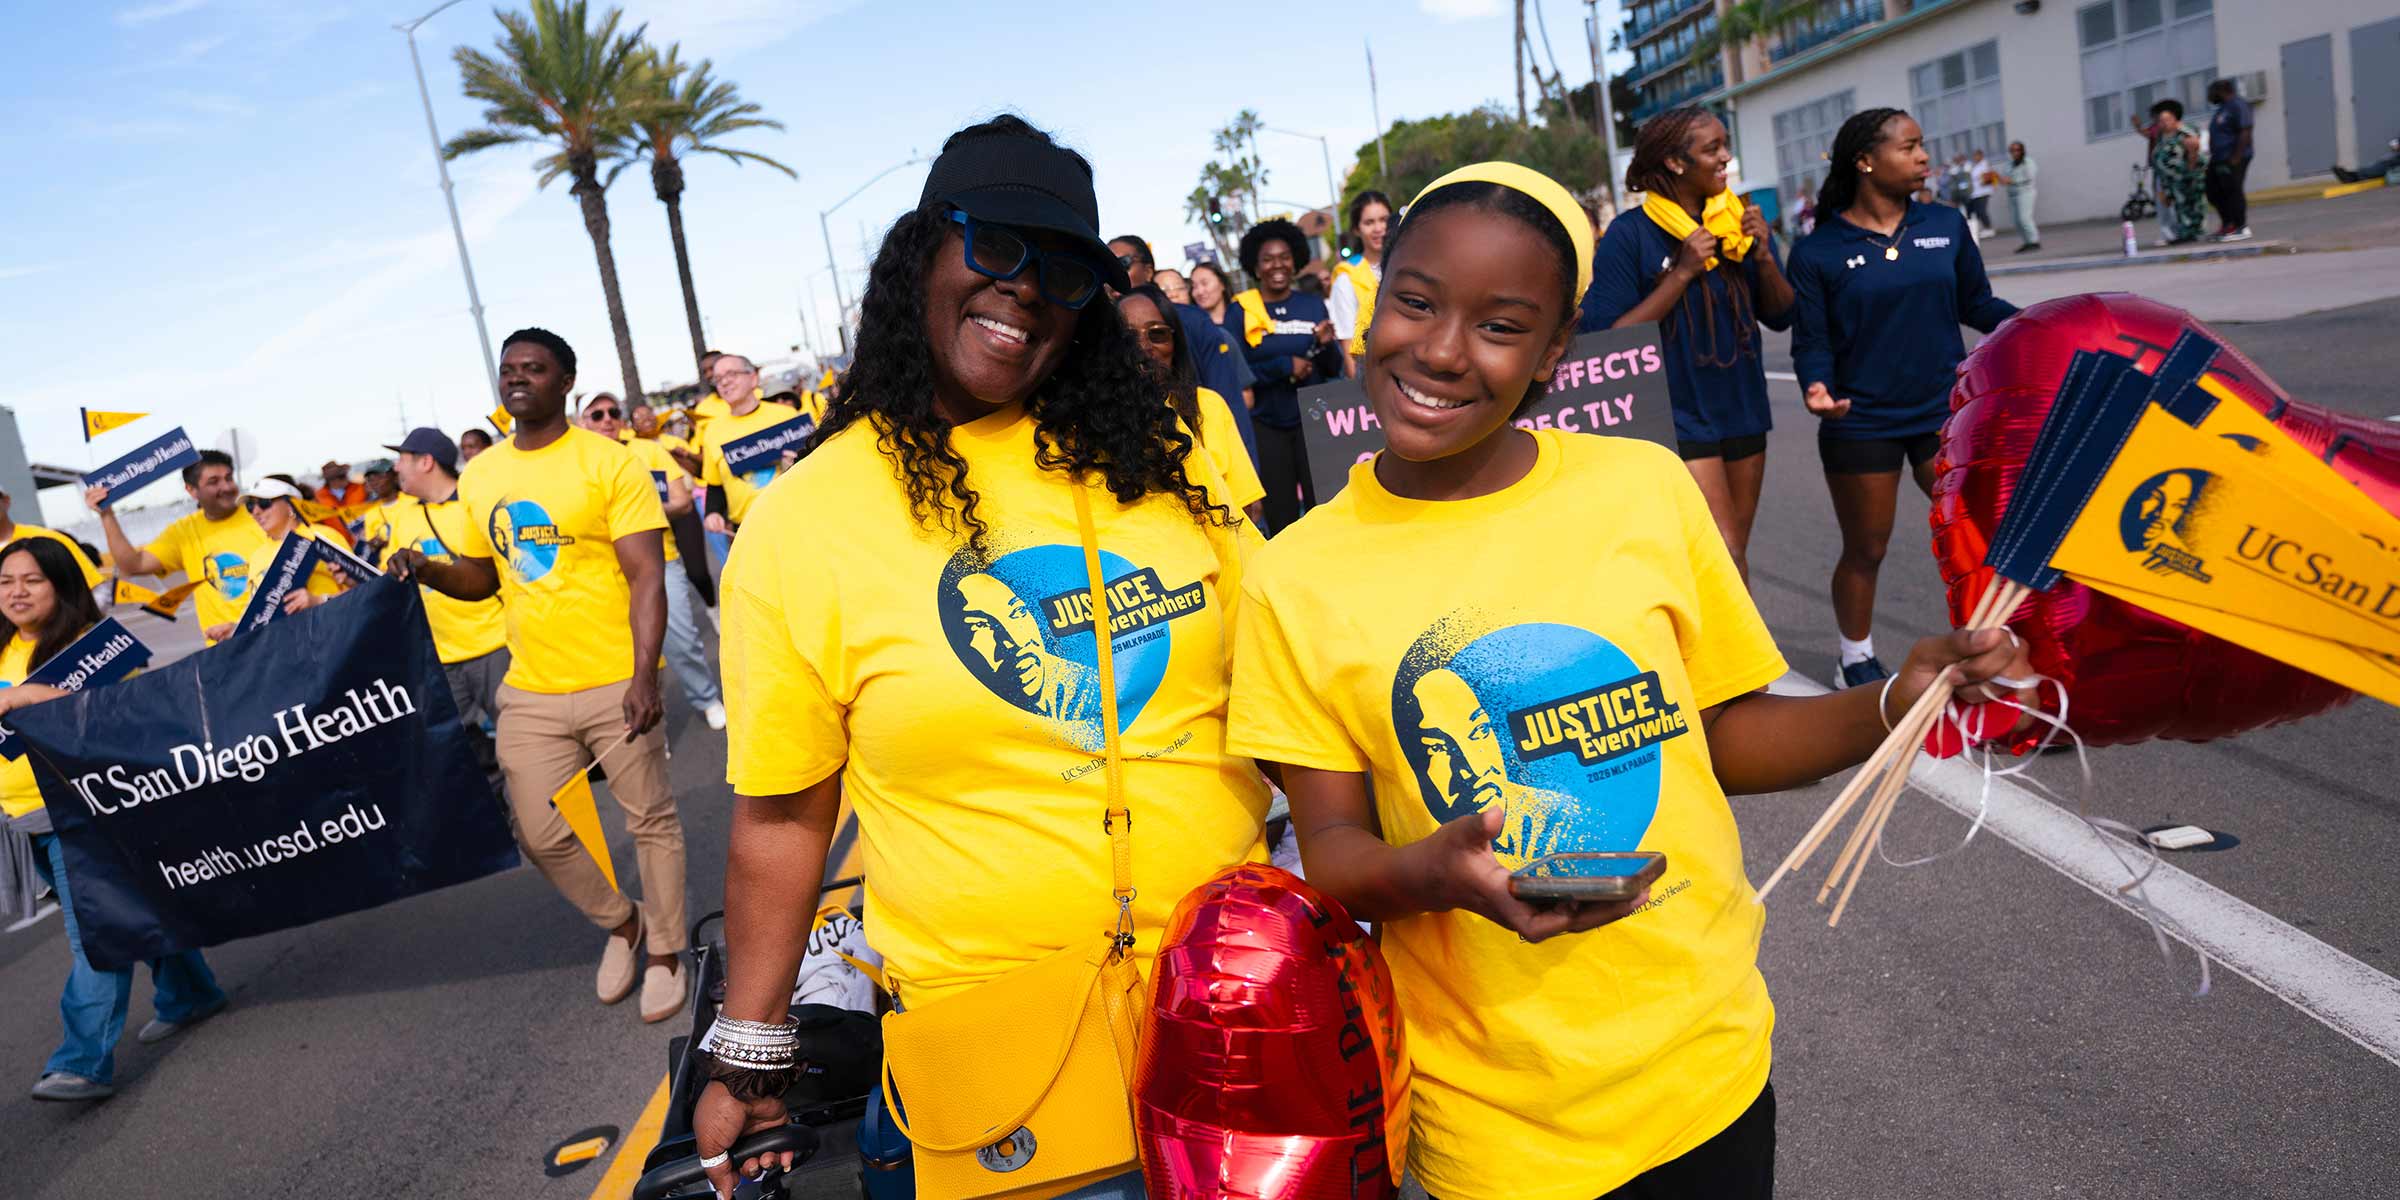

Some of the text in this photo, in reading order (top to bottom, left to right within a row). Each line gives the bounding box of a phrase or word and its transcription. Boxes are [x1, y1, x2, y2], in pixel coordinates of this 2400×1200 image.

[1546, 344, 1661, 394] FFECTS
[107, 471, 131, 489] San
[125, 454, 160, 478] Diego
[153, 438, 192, 463] Health
[2236, 524, 2304, 575] UC
[2294, 552, 2370, 607] San
[1052, 575, 1157, 629] JUSICE
[1108, 588, 1202, 633] verywhere
[77, 633, 135, 676] Health
[1121, 637, 1139, 650] MLK
[1138, 628, 1167, 645] PARADE
[1520, 680, 1656, 752] JUSTICE
[1577, 709, 1686, 759] Everywhe
[106, 764, 182, 809] San
[169, 732, 279, 793] Diego
[273, 678, 417, 758] Health
[1586, 750, 1657, 784] 2026 MLK PARADE
[1061, 767, 1079, 782] UC
[1077, 764, 1092, 777] San
[158, 803, 387, 890] health.ucsd.edu
[1664, 878, 1692, 898] Health
